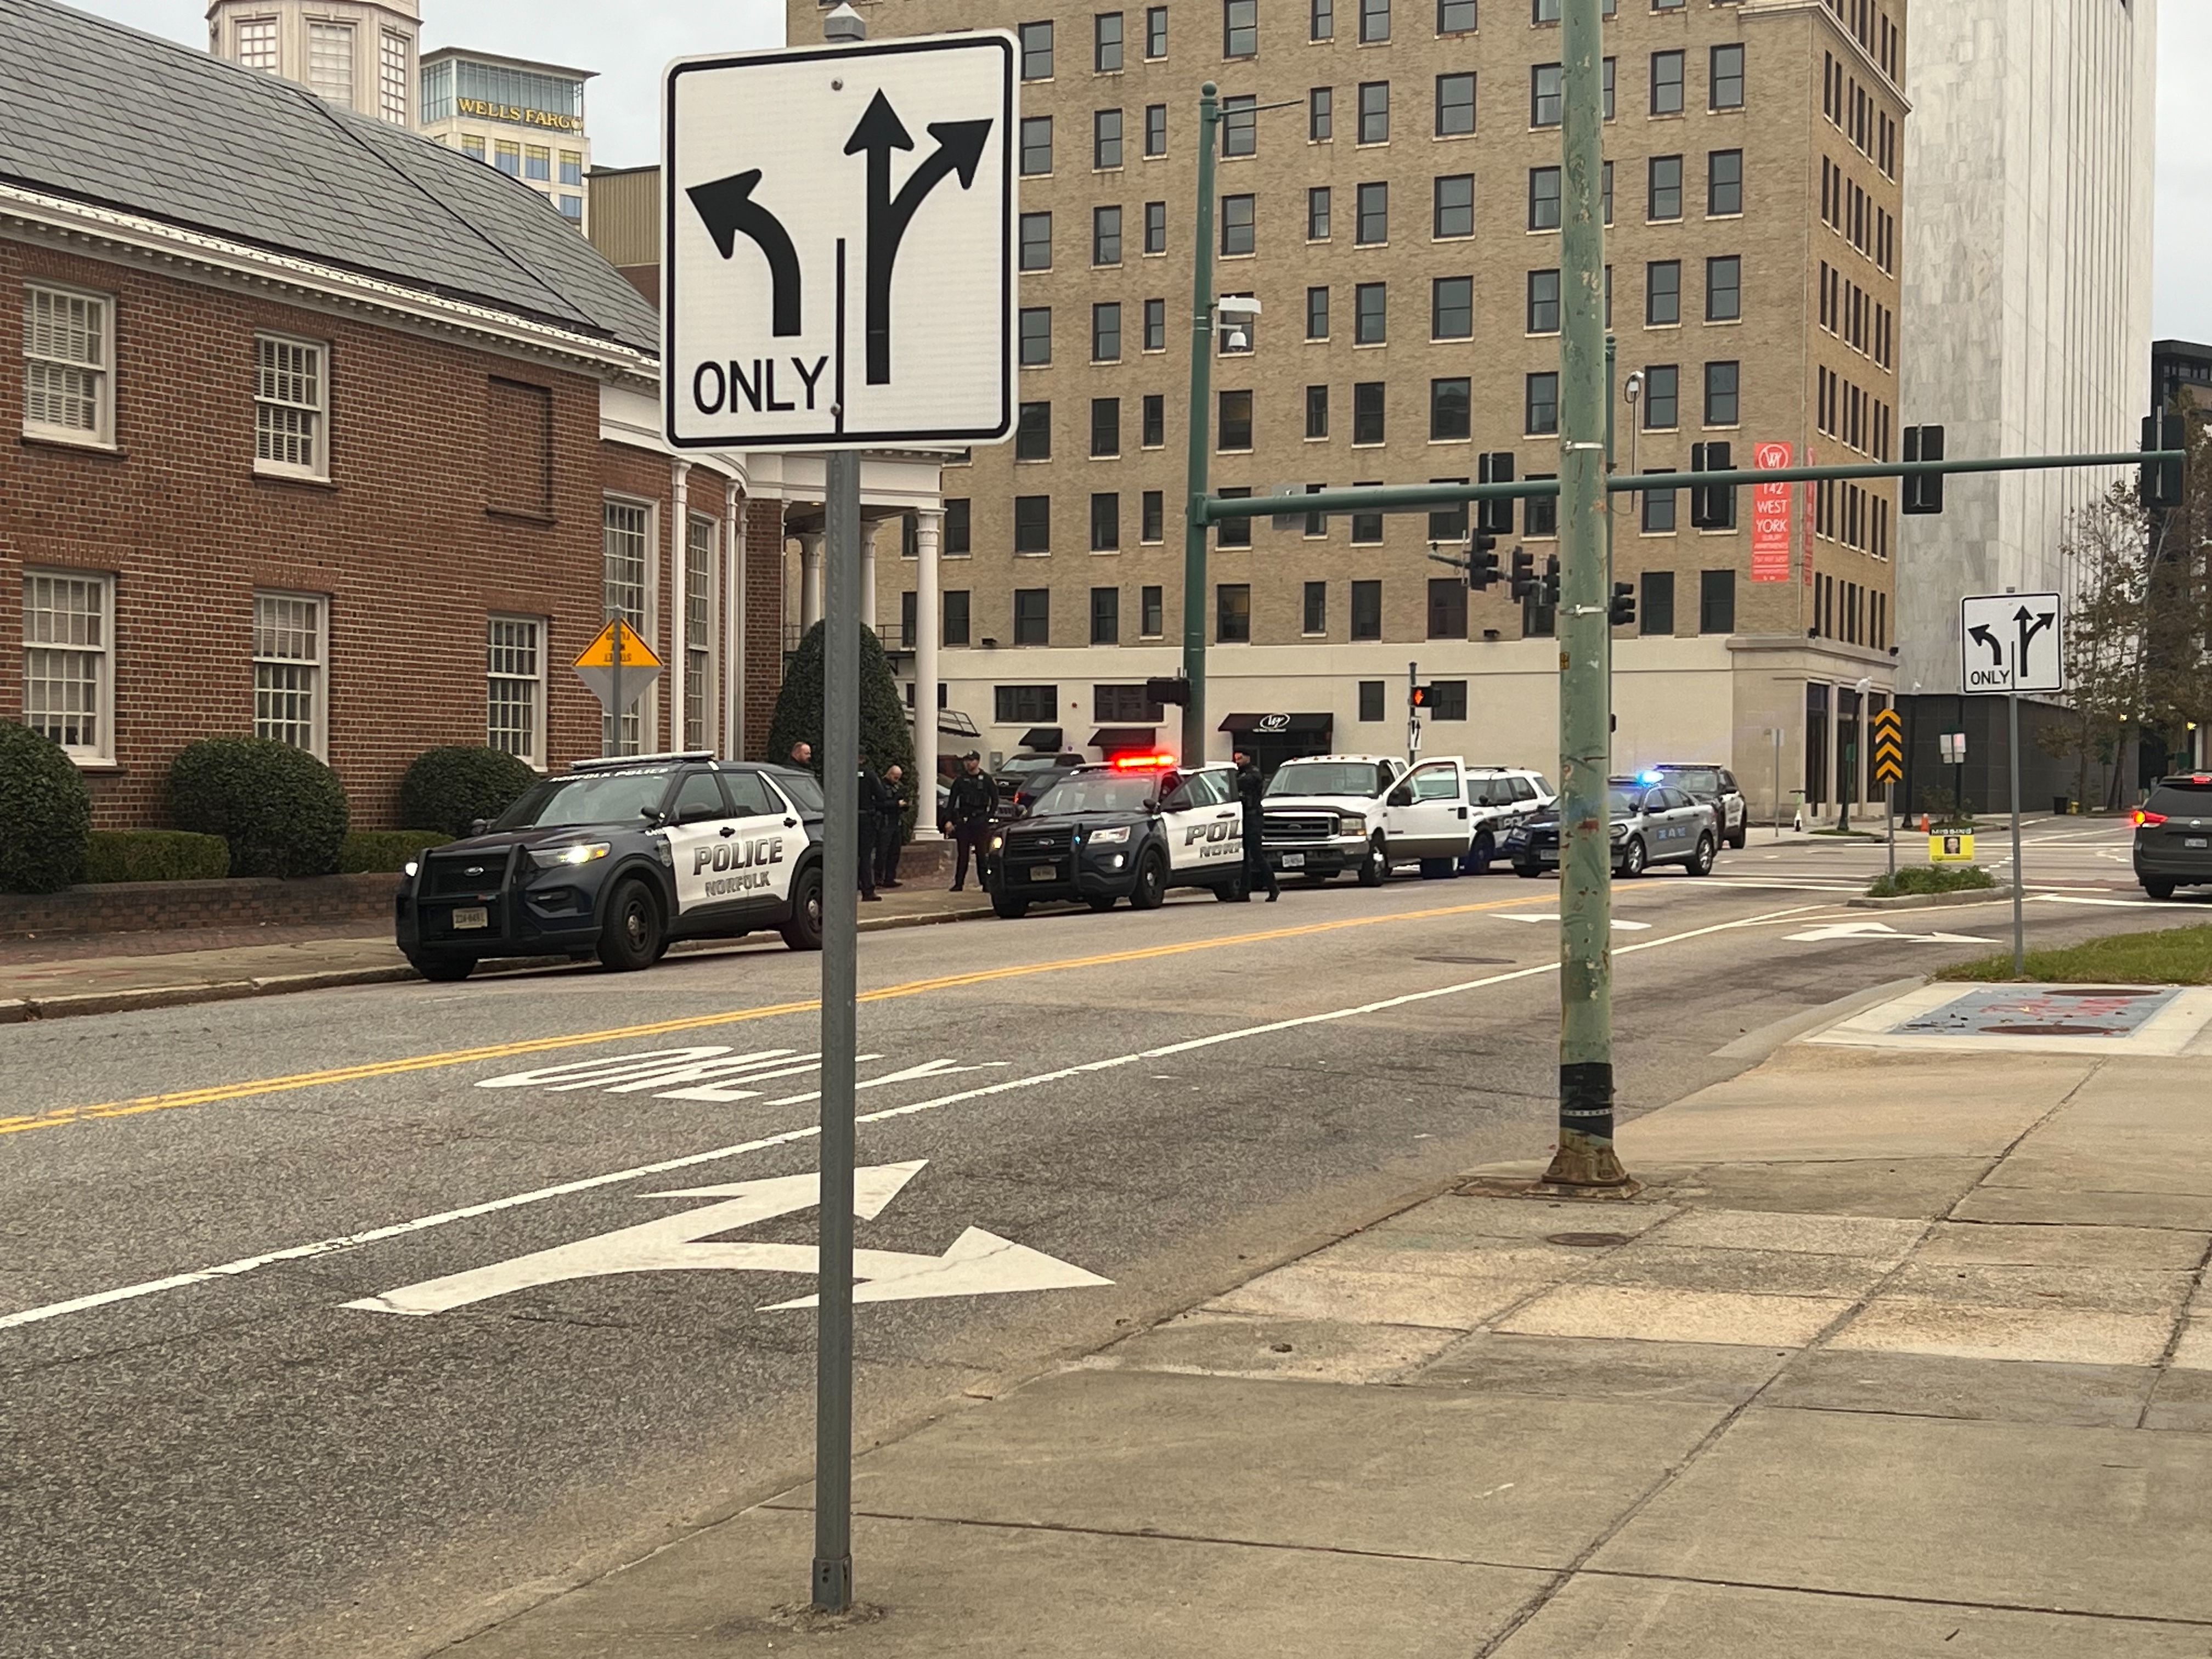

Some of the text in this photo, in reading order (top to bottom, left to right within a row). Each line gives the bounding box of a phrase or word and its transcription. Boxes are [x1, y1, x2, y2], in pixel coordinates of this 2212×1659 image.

[457, 97, 583, 131] WELLS FARGO
[693, 356, 829, 415] ONLY
[1763, 482, 1784, 494] 142
[1757, 499, 1787, 514] WEST
[1756, 518, 1788, 533] YORK
[1971, 670, 2010, 685] ONLY
[1185, 820, 1243, 846] POL
[693, 837, 783, 876] POLICE
[706, 871, 771, 897] NORFOLK
